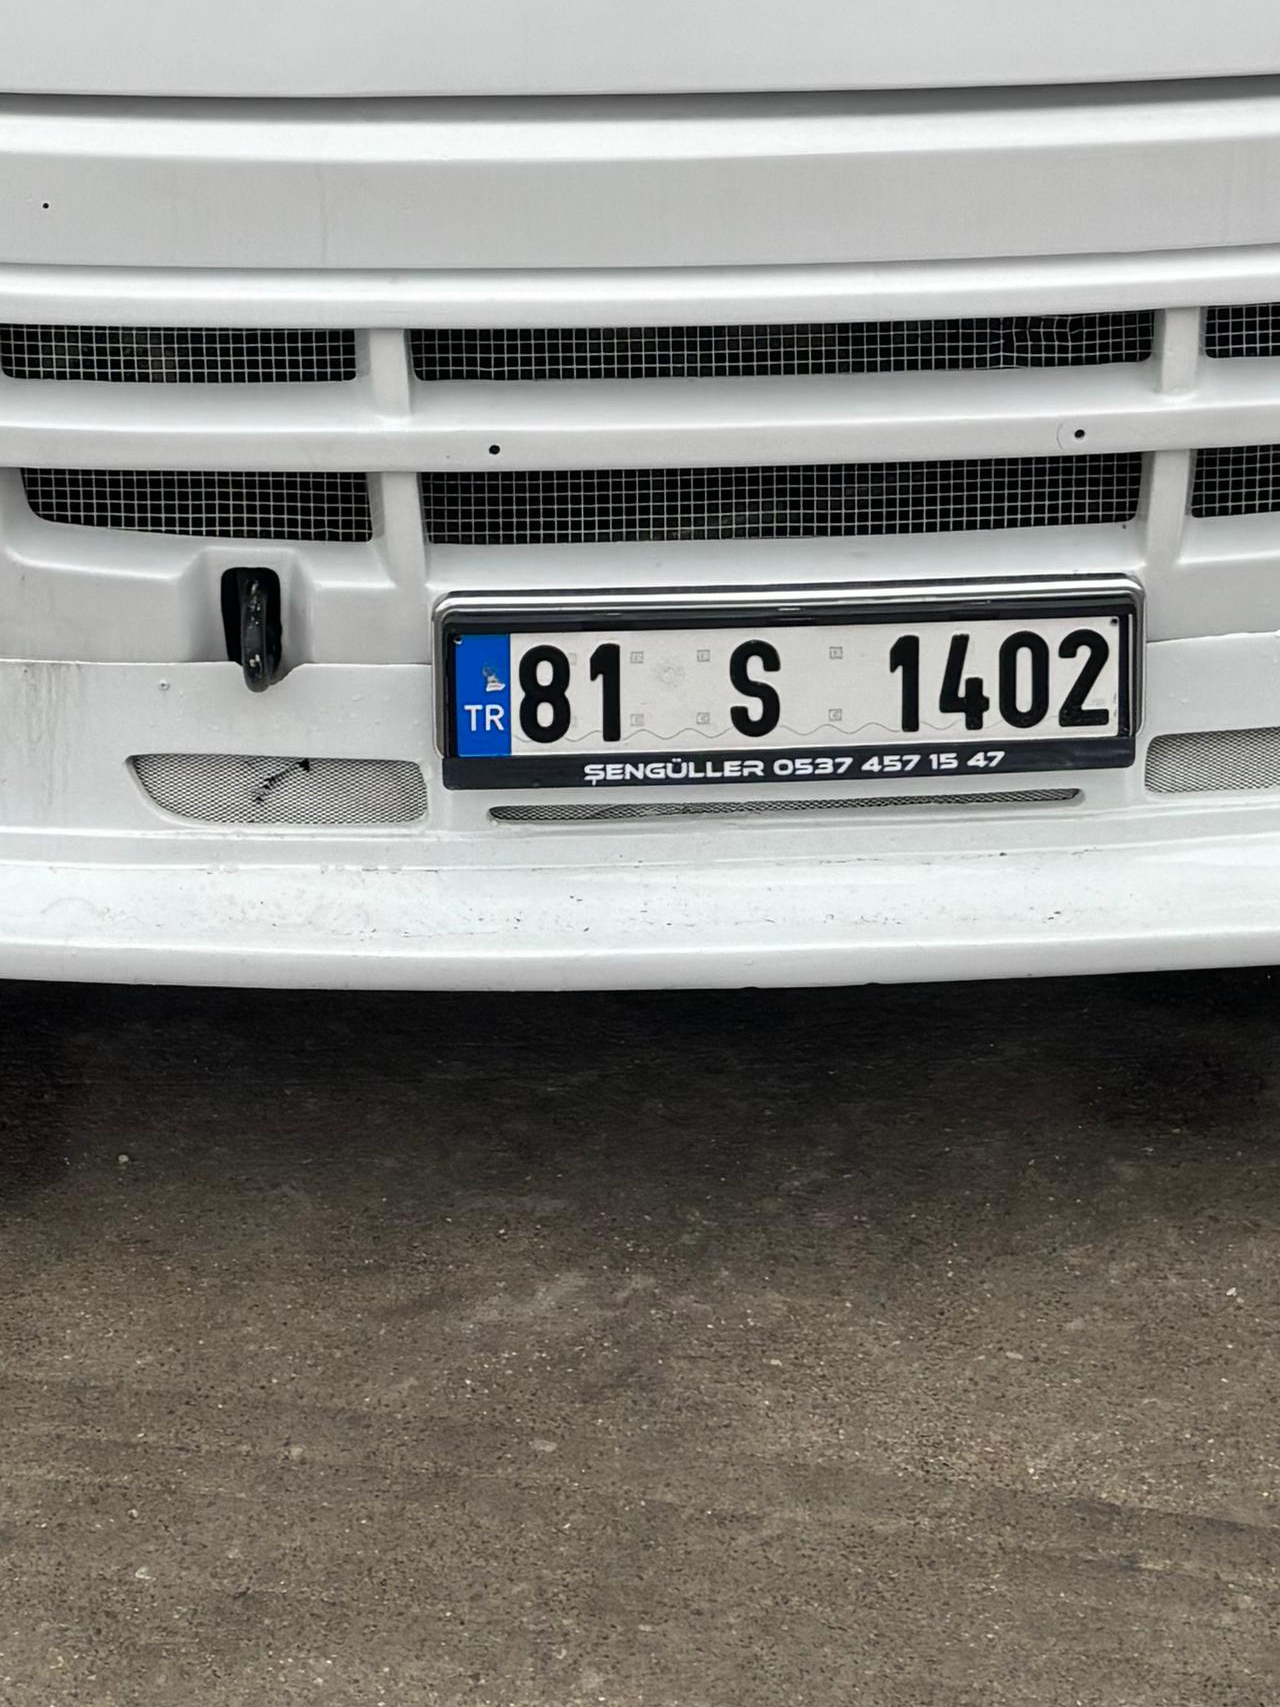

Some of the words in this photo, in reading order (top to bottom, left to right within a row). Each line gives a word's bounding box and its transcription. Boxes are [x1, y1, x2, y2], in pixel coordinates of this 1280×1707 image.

[519, 643, 621, 744] 81
[730, 639, 781, 738] S
[889, 628, 1110, 733] 1402
[464, 703, 505, 731] TR
[583, 757, 764, 786] ŞENGÜLLER
[773, 757, 853, 777] 0537
[861, 754, 921, 773] 457
[930, 753, 959, 771] 15
[966, 751, 1006, 768] 47
